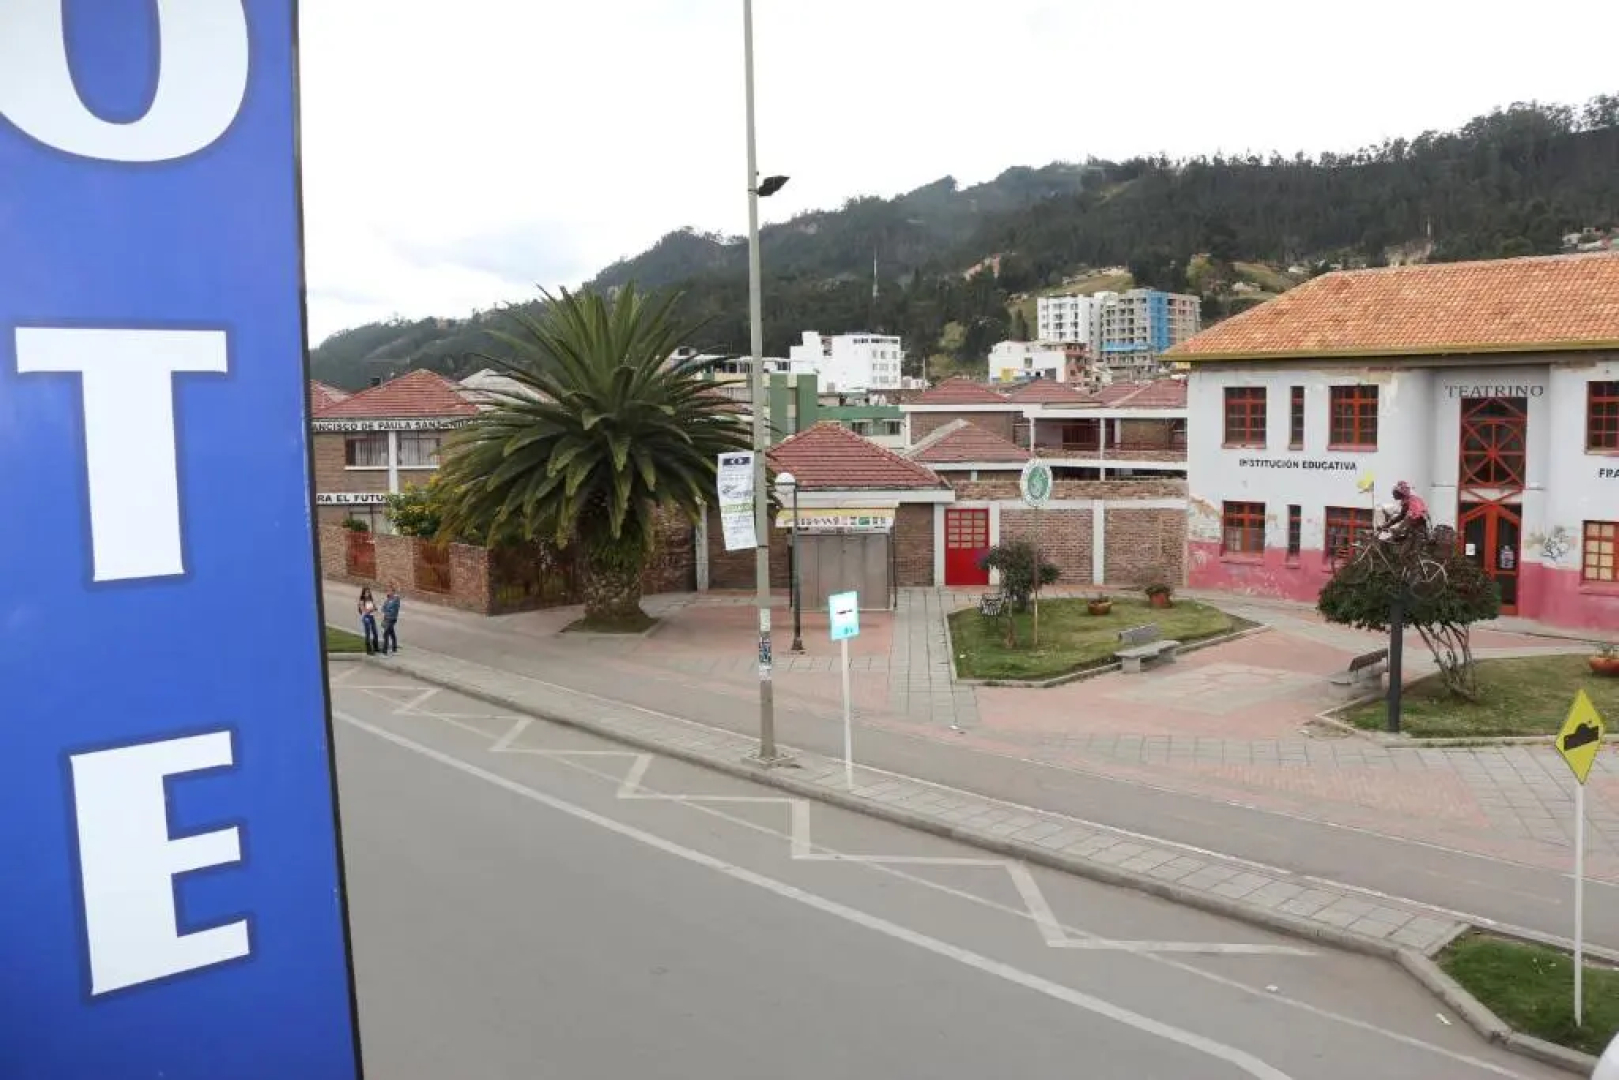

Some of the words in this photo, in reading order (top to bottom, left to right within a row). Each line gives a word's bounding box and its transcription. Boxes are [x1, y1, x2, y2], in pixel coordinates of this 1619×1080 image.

[1445, 384, 1544, 397] TEATRINO
[361, 422, 374, 431] DE
[378, 421, 411, 430] PAULA
[1302, 460, 1356, 471] EDUCATIVA
[336, 494, 350, 502] EL
[353, 494, 386, 502] FUTU
